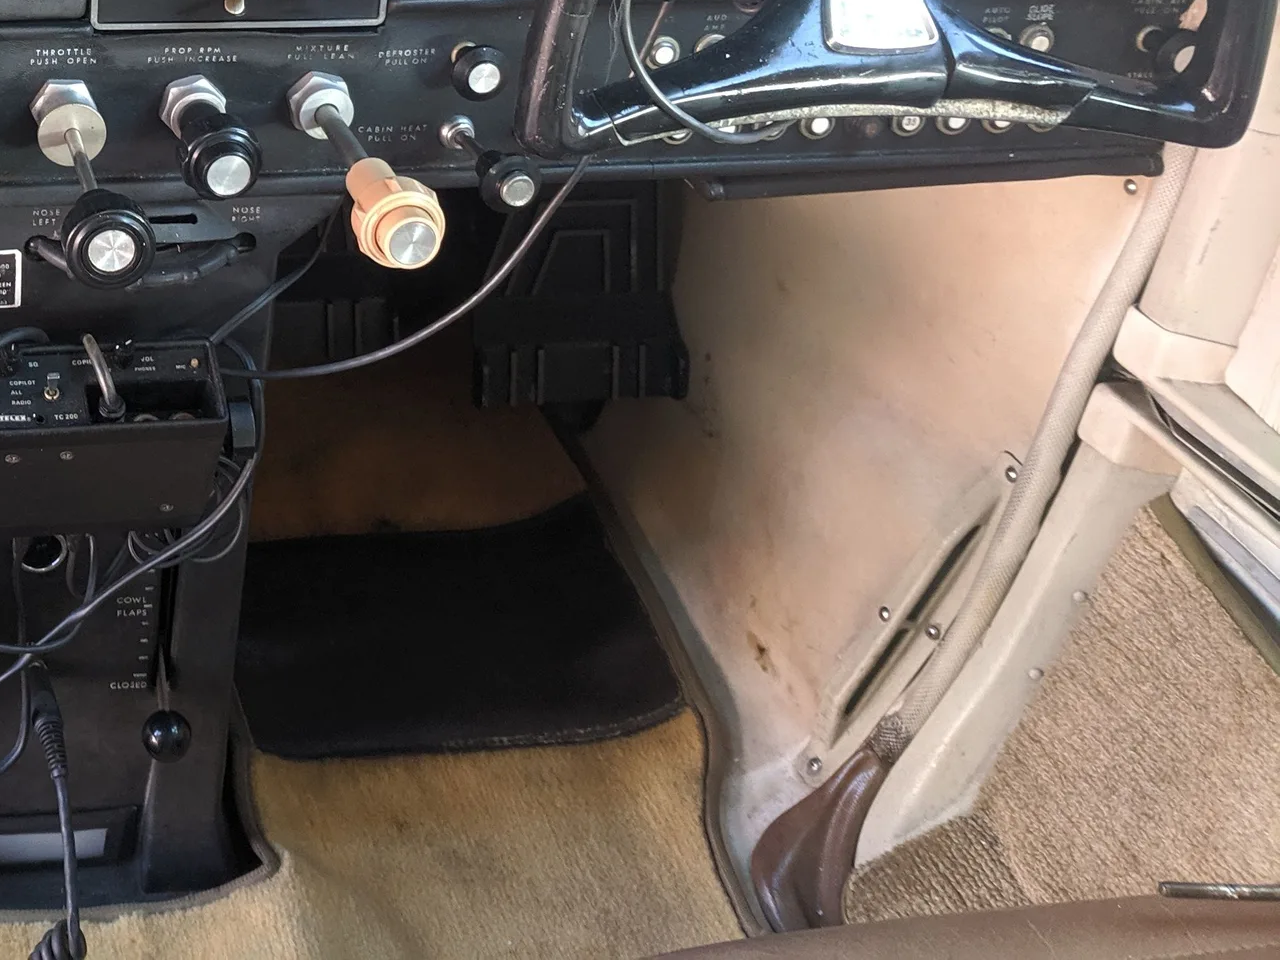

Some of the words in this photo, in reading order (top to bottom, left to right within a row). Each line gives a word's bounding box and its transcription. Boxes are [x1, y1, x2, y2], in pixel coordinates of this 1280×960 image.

[1028, 4, 1055, 14] GLIDE
[1025, 13, 1055, 21] SLOPE
[36, 48, 92, 56] THROTTLE
[164, 47, 193, 55] PROP
[200, 46, 221, 54] RPM
[296, 44, 349, 52] MIXTURE
[378, 48, 436, 59] DEFROSTER
[30, 57, 58, 66] PUSH
[67, 57, 97, 65] OPEN
[185, 55, 238, 63] INCREASE
[357, 125, 394, 133] CABIN
[32, 209, 61, 217] NOSE
[233, 206, 261, 214] NOSE
[32, 218, 56, 226] LEFT
[116, 596, 147, 604] COWL
[117, 608, 148, 617] FLAPS
[110, 681, 147, 690] CLOSED
